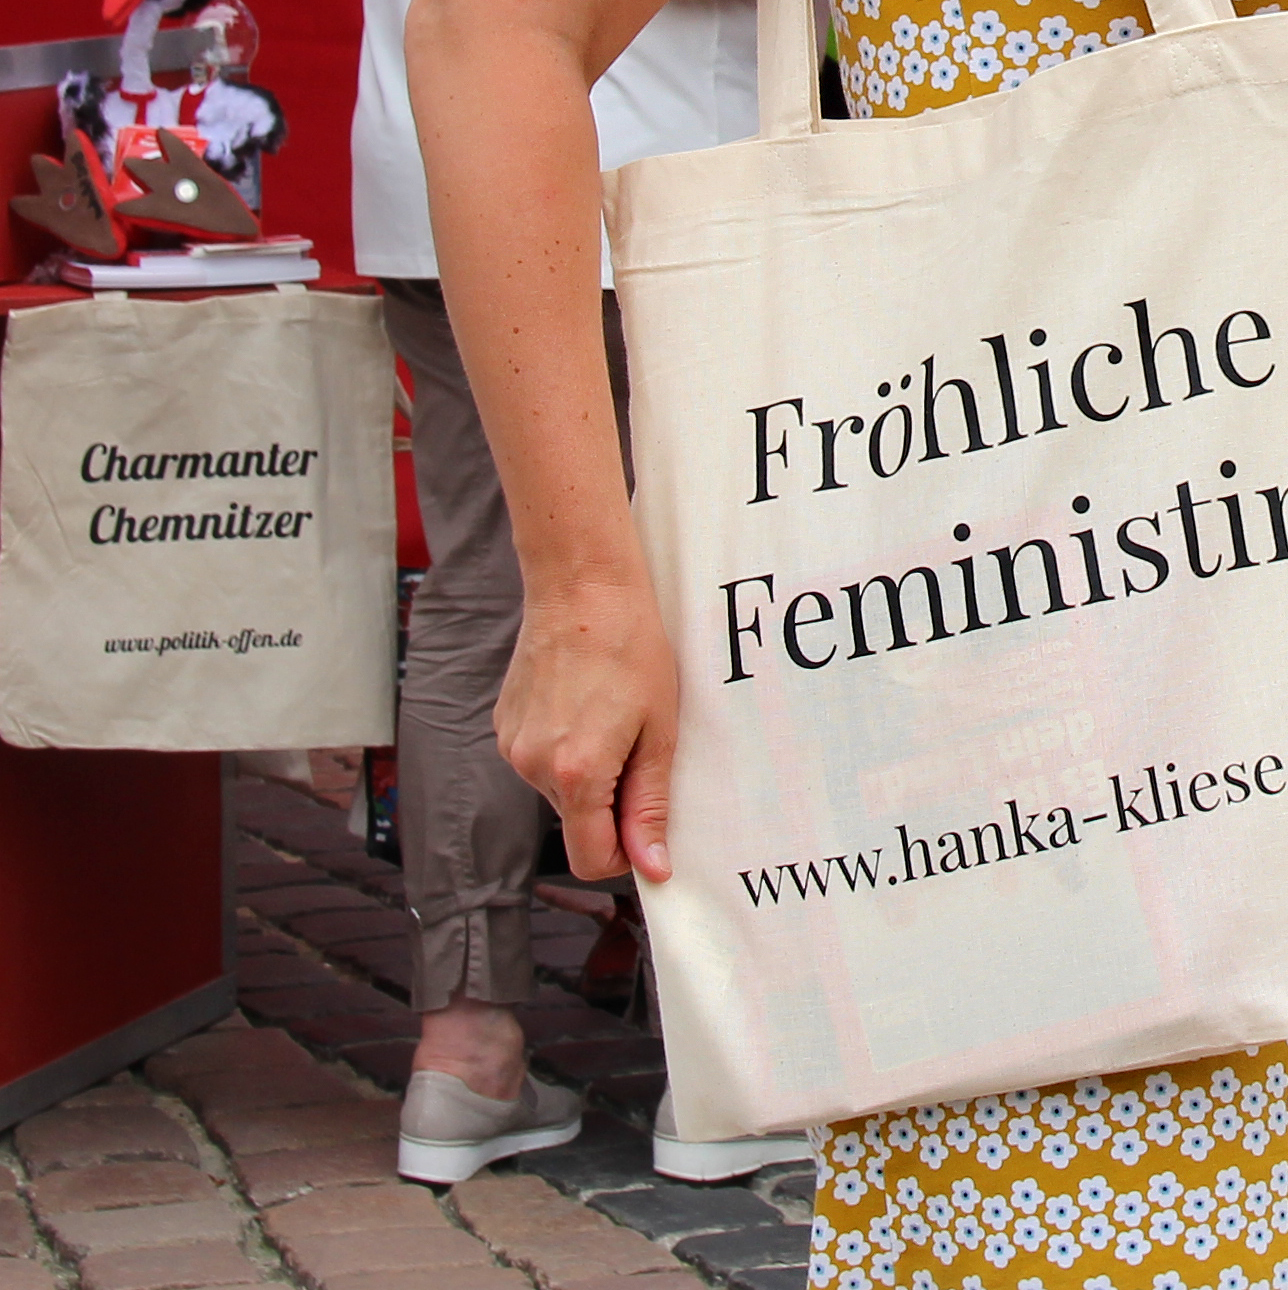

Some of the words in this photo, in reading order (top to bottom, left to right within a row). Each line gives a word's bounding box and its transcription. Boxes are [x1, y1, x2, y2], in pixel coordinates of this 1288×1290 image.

[745, 298, 1277, 505] Fröhliche
[81, 443, 318, 483] Charmanter
[90, 501, 313, 545] Chemnitzer
[104, 628, 303, 656] www.politik-offen.de
